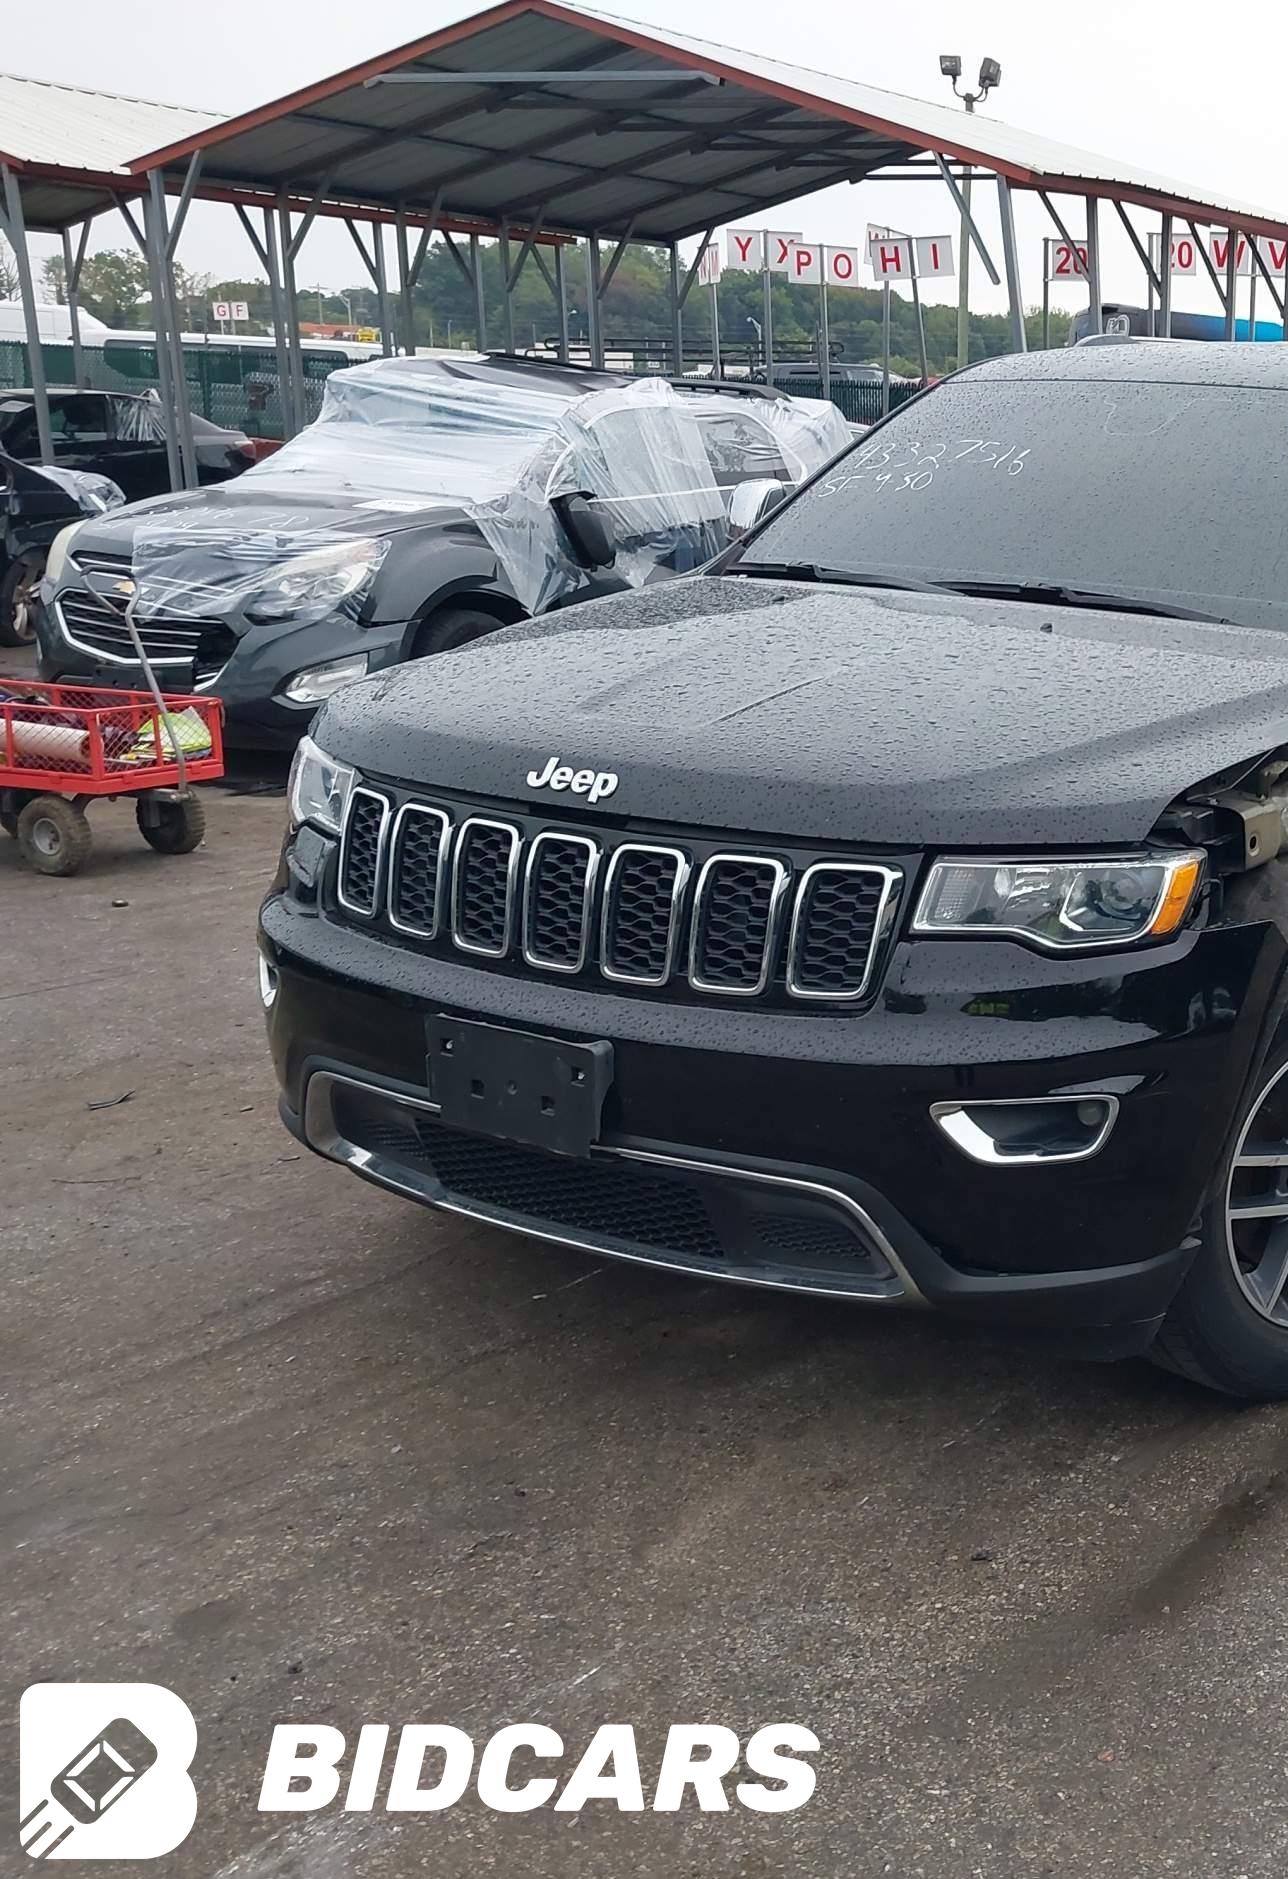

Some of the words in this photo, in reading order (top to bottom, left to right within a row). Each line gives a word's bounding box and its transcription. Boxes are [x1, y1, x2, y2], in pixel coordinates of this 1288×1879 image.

[734, 236, 753, 262] Y
[880, 246, 902, 273] H
[932, 243, 940, 270] I
[797, 250, 812, 276] P
[833, 253, 852, 279] O
[526, 757, 619, 803] Jeep
